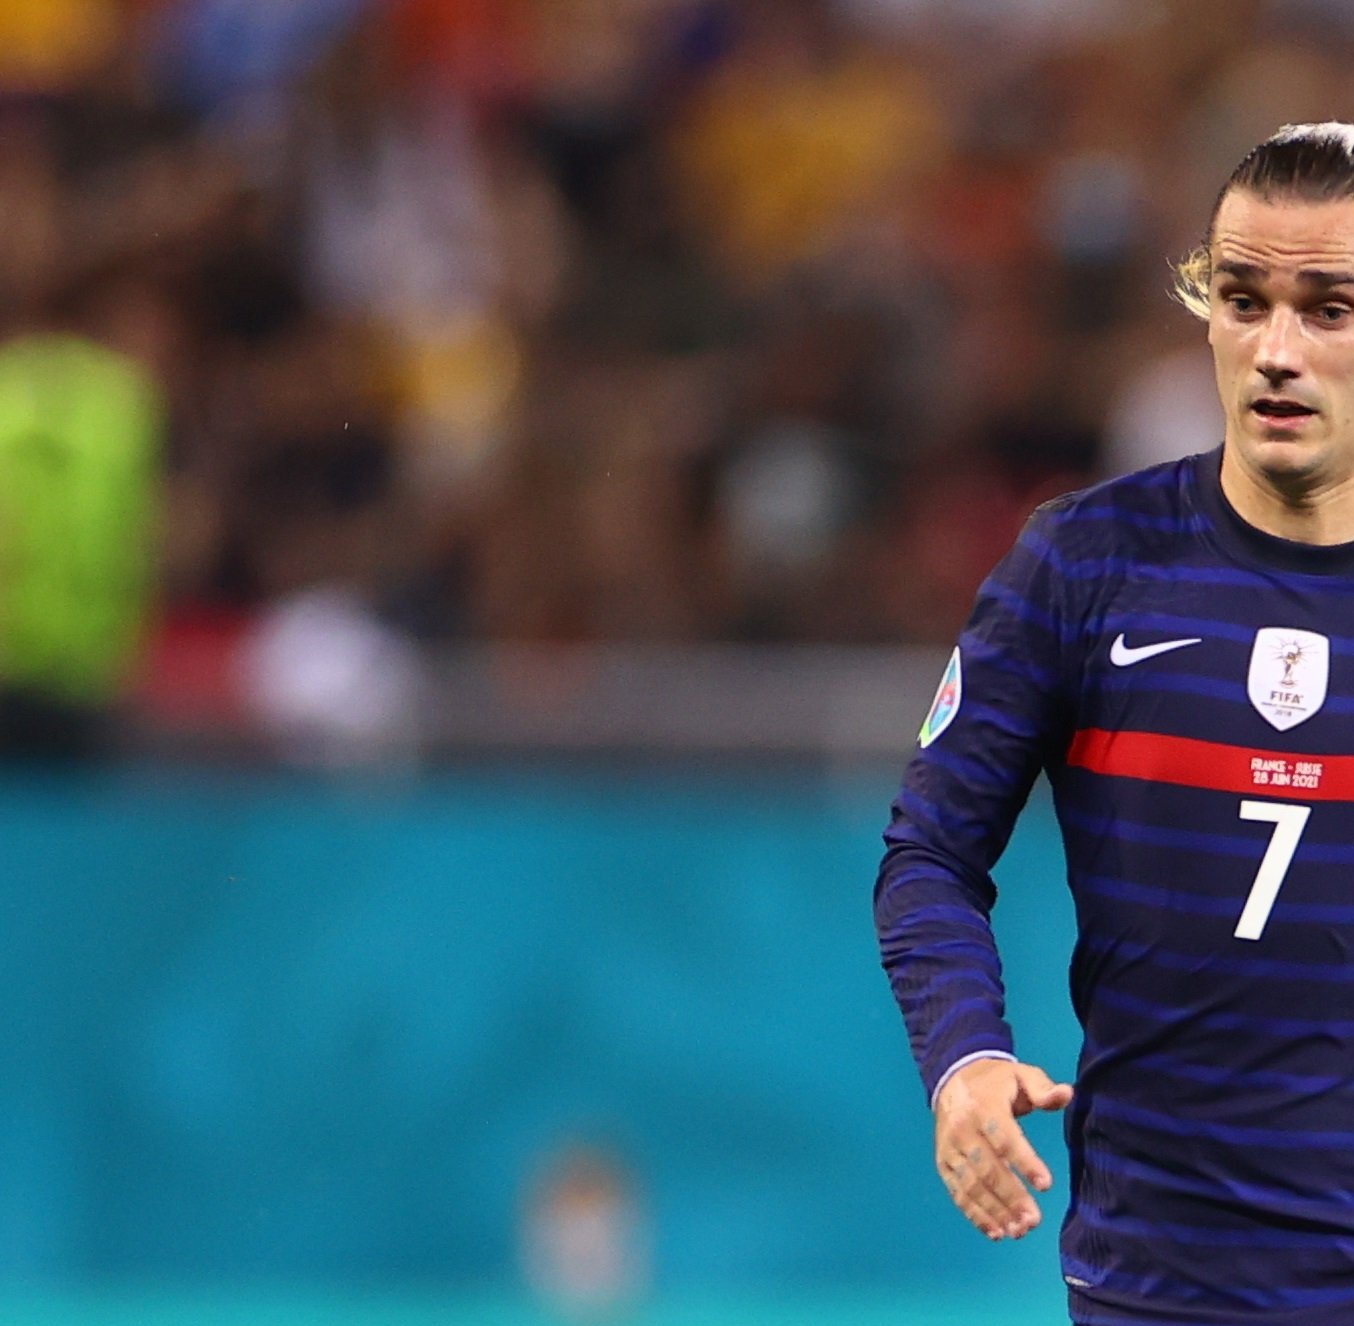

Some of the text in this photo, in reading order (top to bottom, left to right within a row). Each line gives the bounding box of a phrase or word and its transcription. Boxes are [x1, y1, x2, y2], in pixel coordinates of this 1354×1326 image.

[1270, 690, 1301, 704] FIFA
[1251, 758, 1286, 773] FRANCE
[1292, 774, 1318, 788] 2021
[1233, 800, 1312, 940] 7
